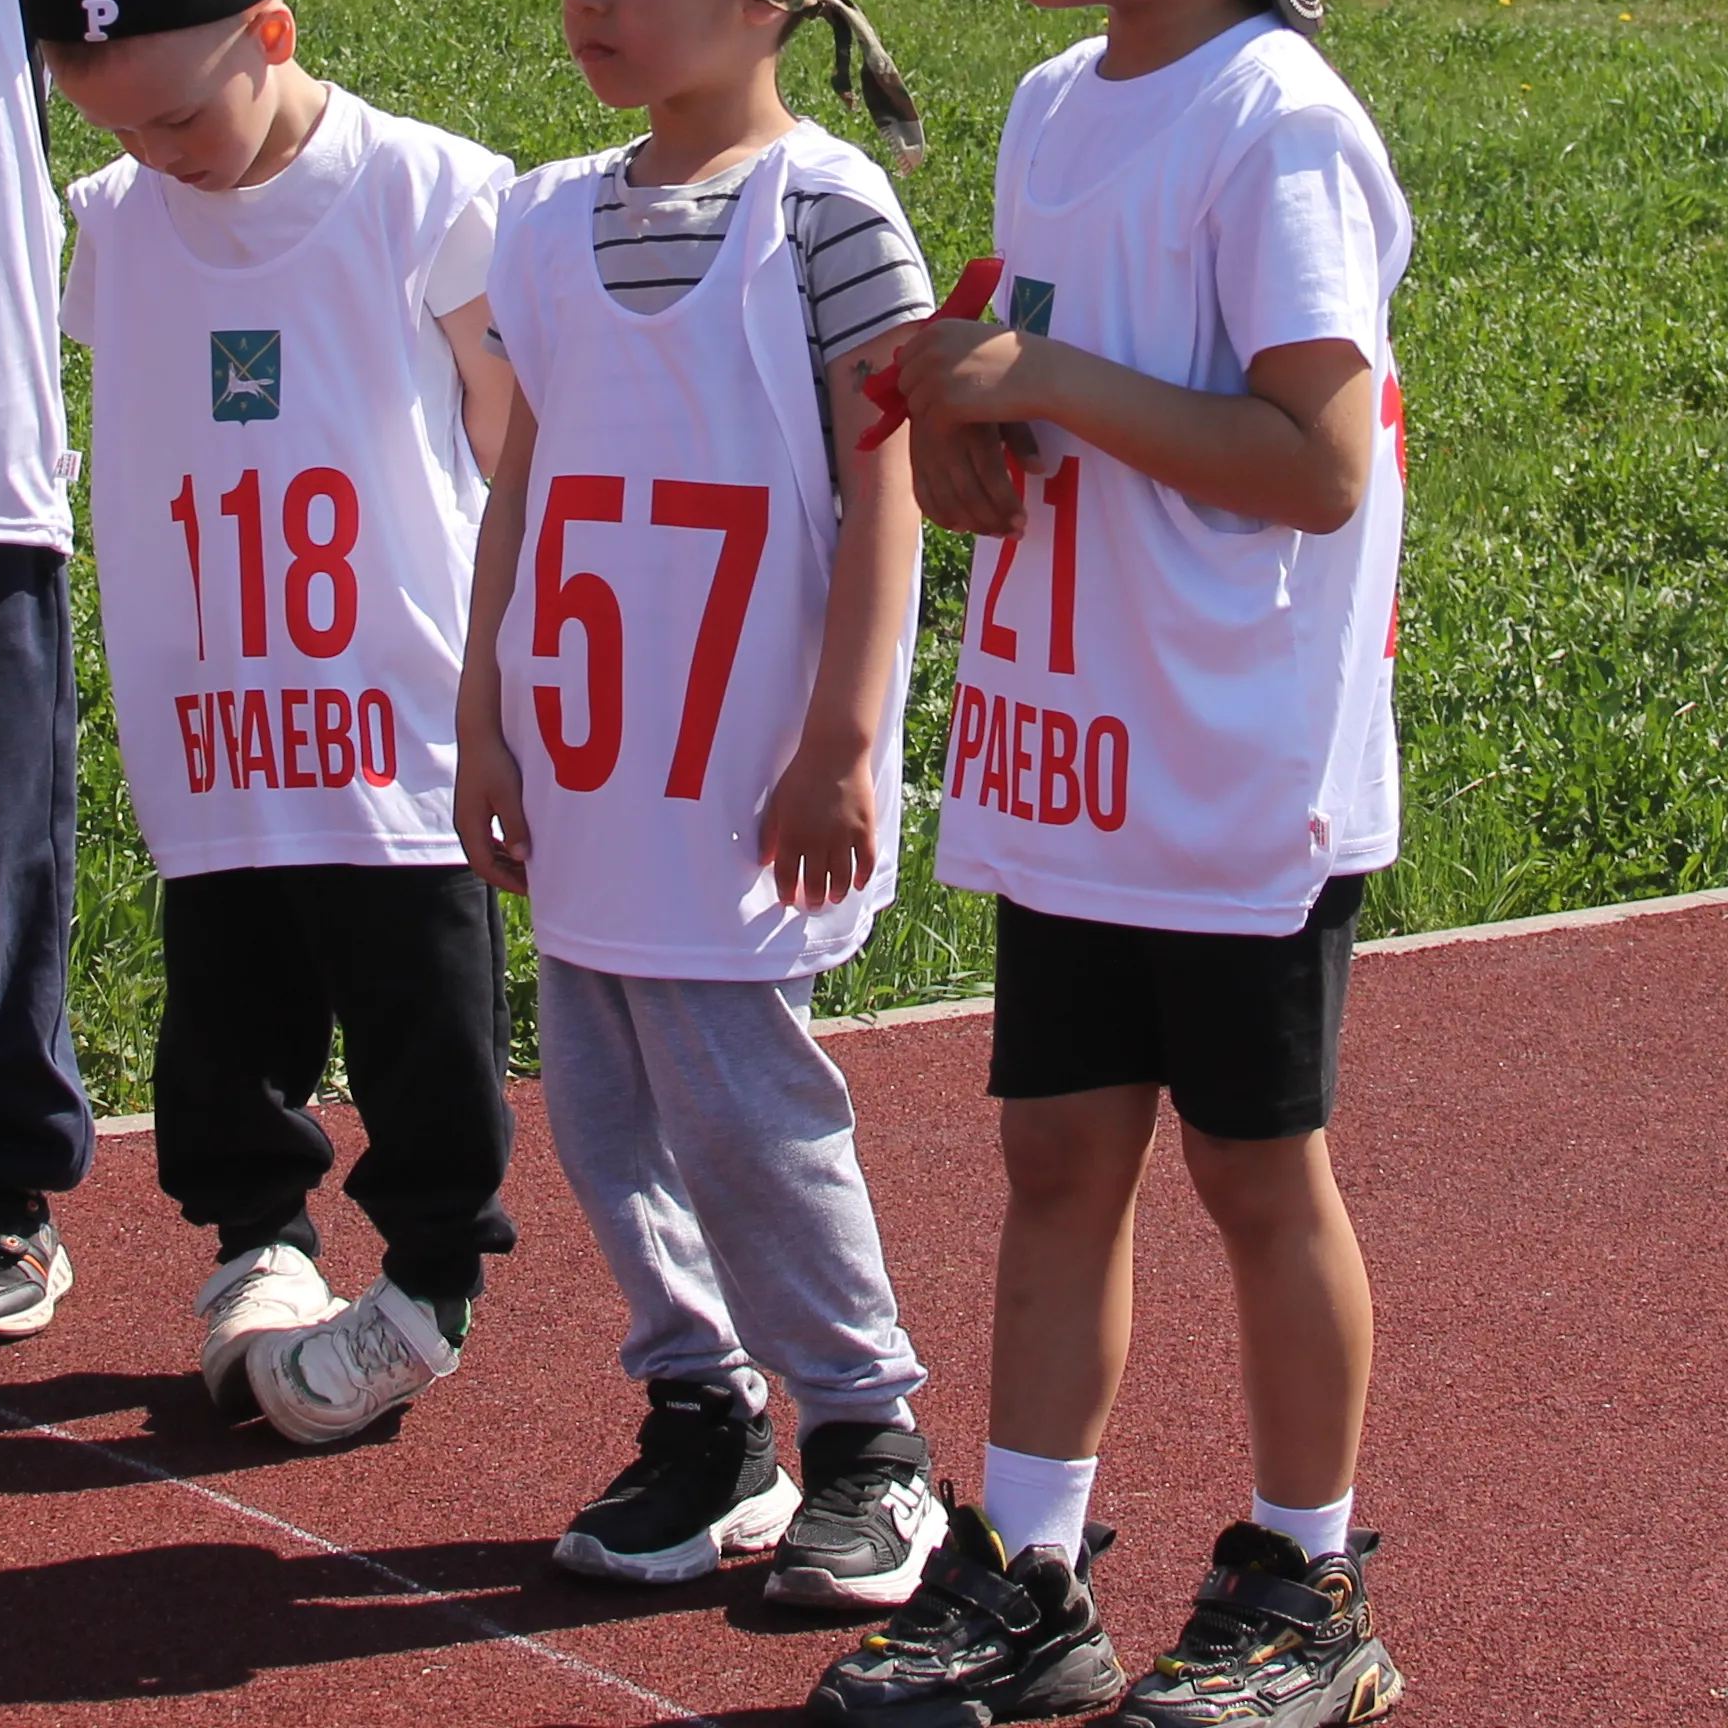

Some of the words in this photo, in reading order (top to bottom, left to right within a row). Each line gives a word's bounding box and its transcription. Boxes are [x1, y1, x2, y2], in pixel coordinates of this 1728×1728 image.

[170, 466, 360, 661] 118
[532, 474, 769, 801] 57
[962, 442, 1080, 674] 21
[947, 682, 1130, 833] РАЕВО
[666, 1399, 702, 1411] FASHION
